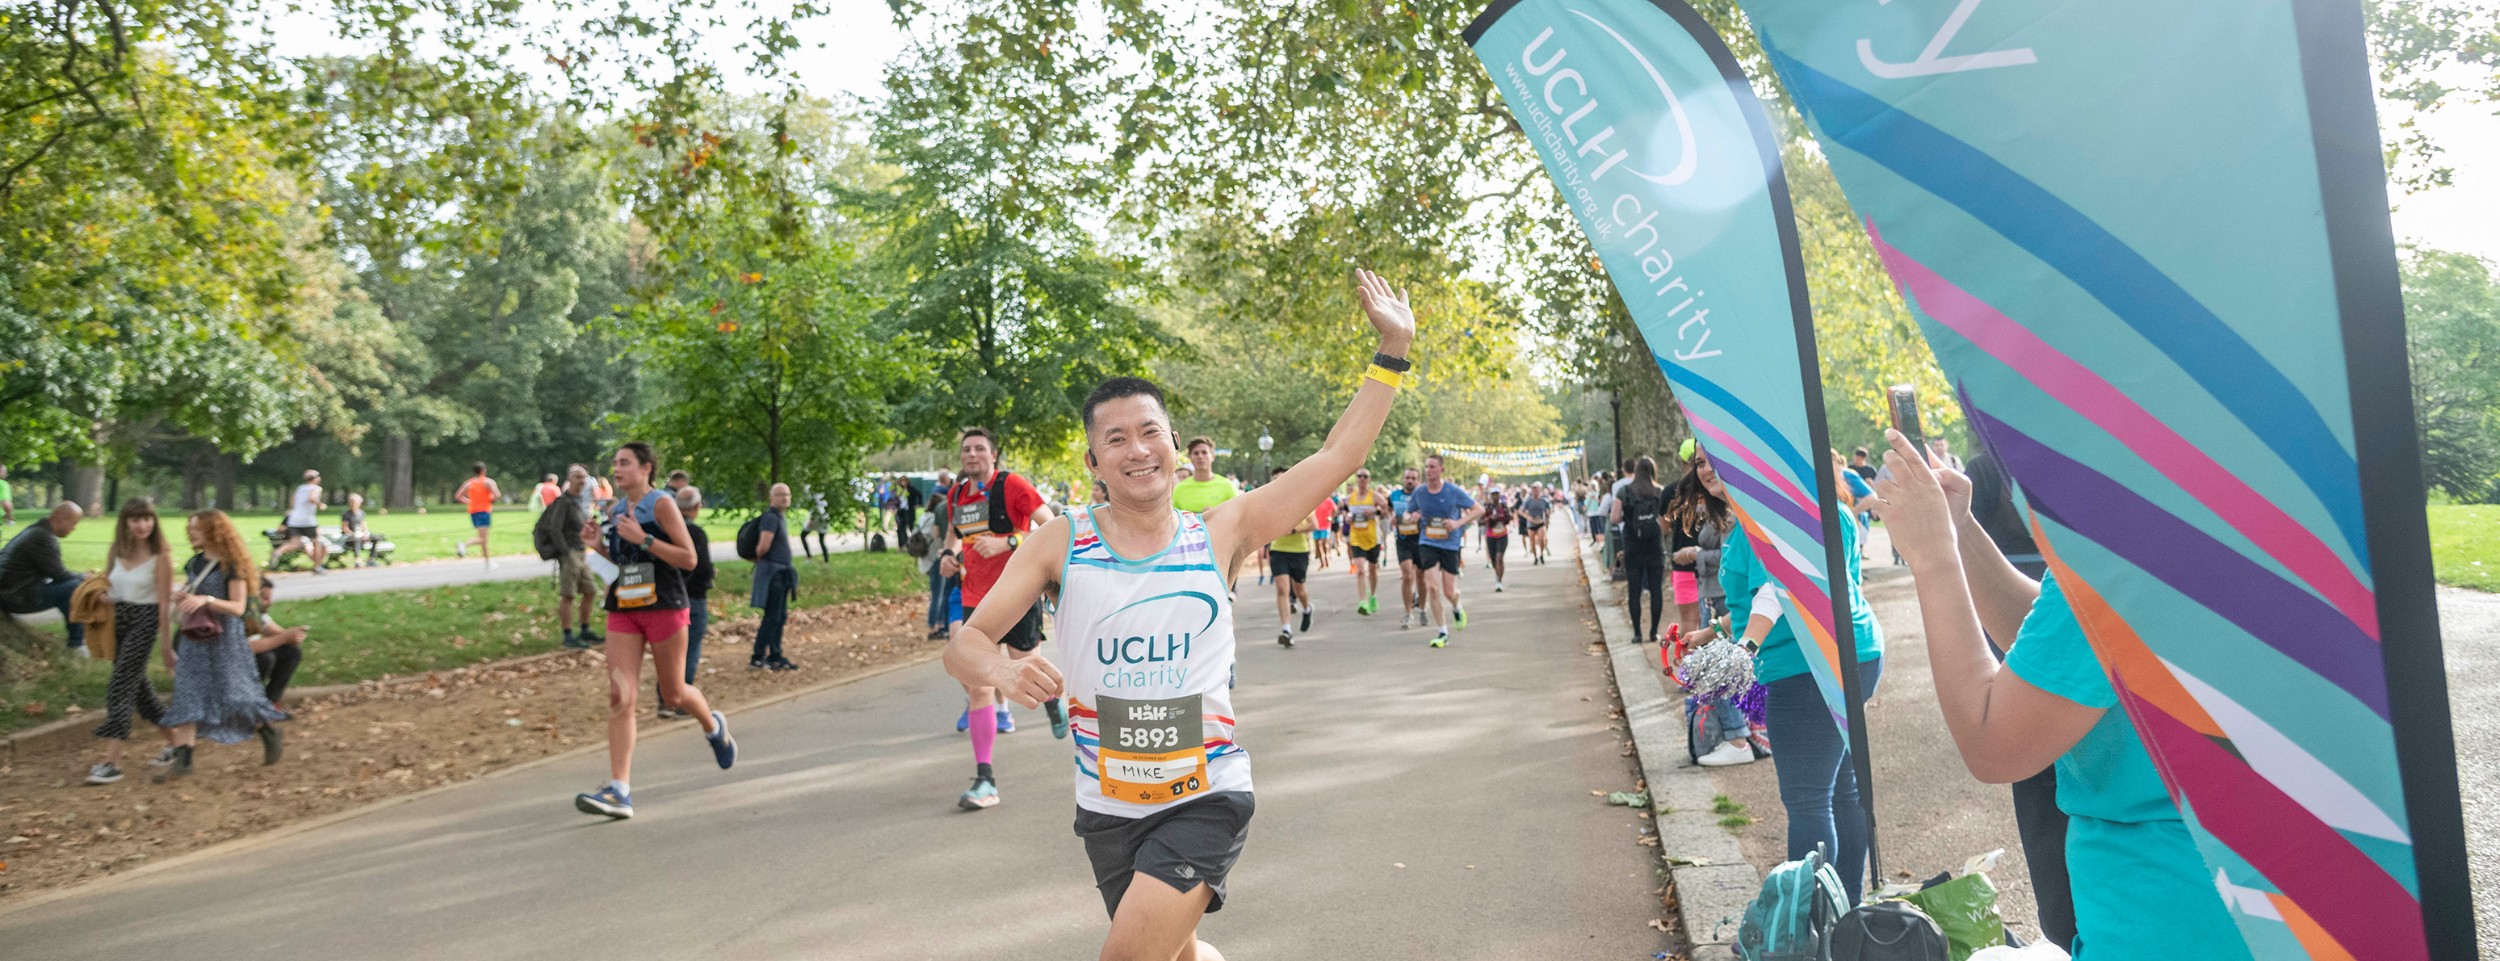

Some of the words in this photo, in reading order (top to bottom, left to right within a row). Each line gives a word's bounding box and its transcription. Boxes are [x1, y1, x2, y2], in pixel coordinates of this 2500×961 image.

[1856, 0, 2038, 79] y
[1505, 62, 1611, 240] www.uclhcharity.org.uk
[1522, 26, 1629, 182] UCLH
[1612, 193, 1723, 361] charity
[1098, 633, 1190, 665] UCLH
[1103, 665, 1188, 689] charity
[1129, 703, 1167, 720] Half
[1119, 726, 1179, 748] 5893
[1123, 765, 1164, 779] MIKE
[1189, 779, 1198, 788] M
